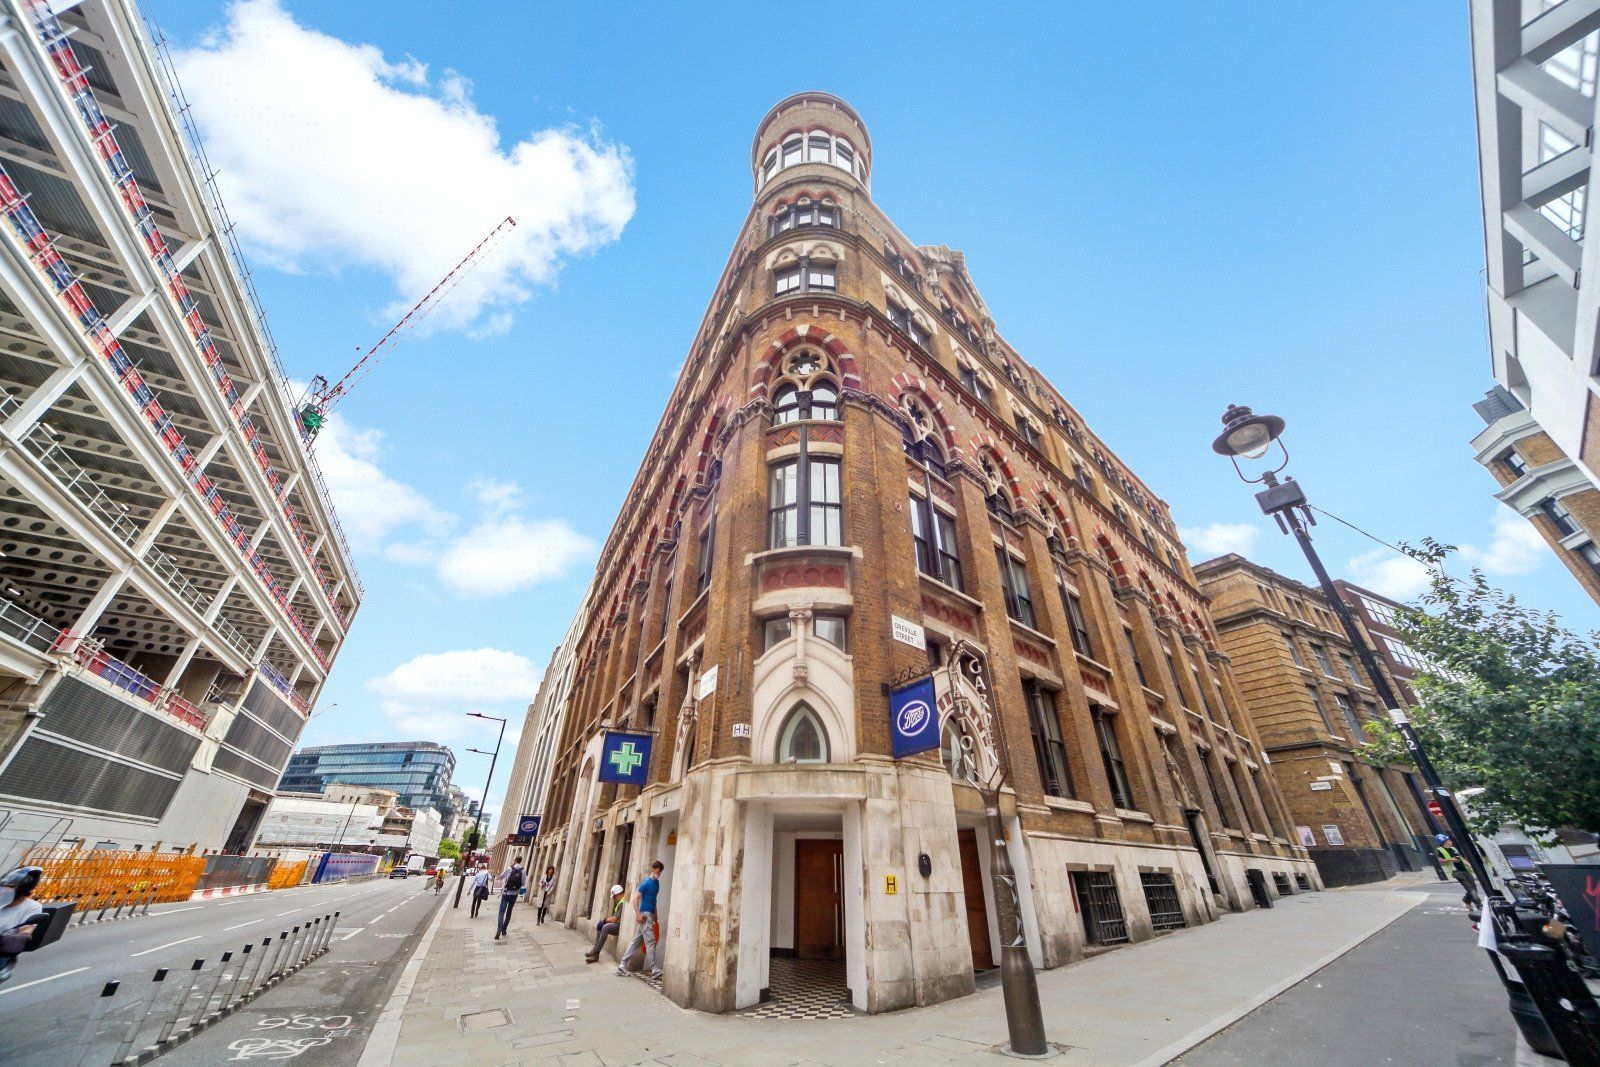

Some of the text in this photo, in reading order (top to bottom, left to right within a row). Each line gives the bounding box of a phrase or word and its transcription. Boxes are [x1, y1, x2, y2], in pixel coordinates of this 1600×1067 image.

[894, 622, 917, 637] GREVILLE
[895, 630, 914, 643] STREET
[886, 876, 896, 892] H
[251, 1015, 352, 1031] CS6
